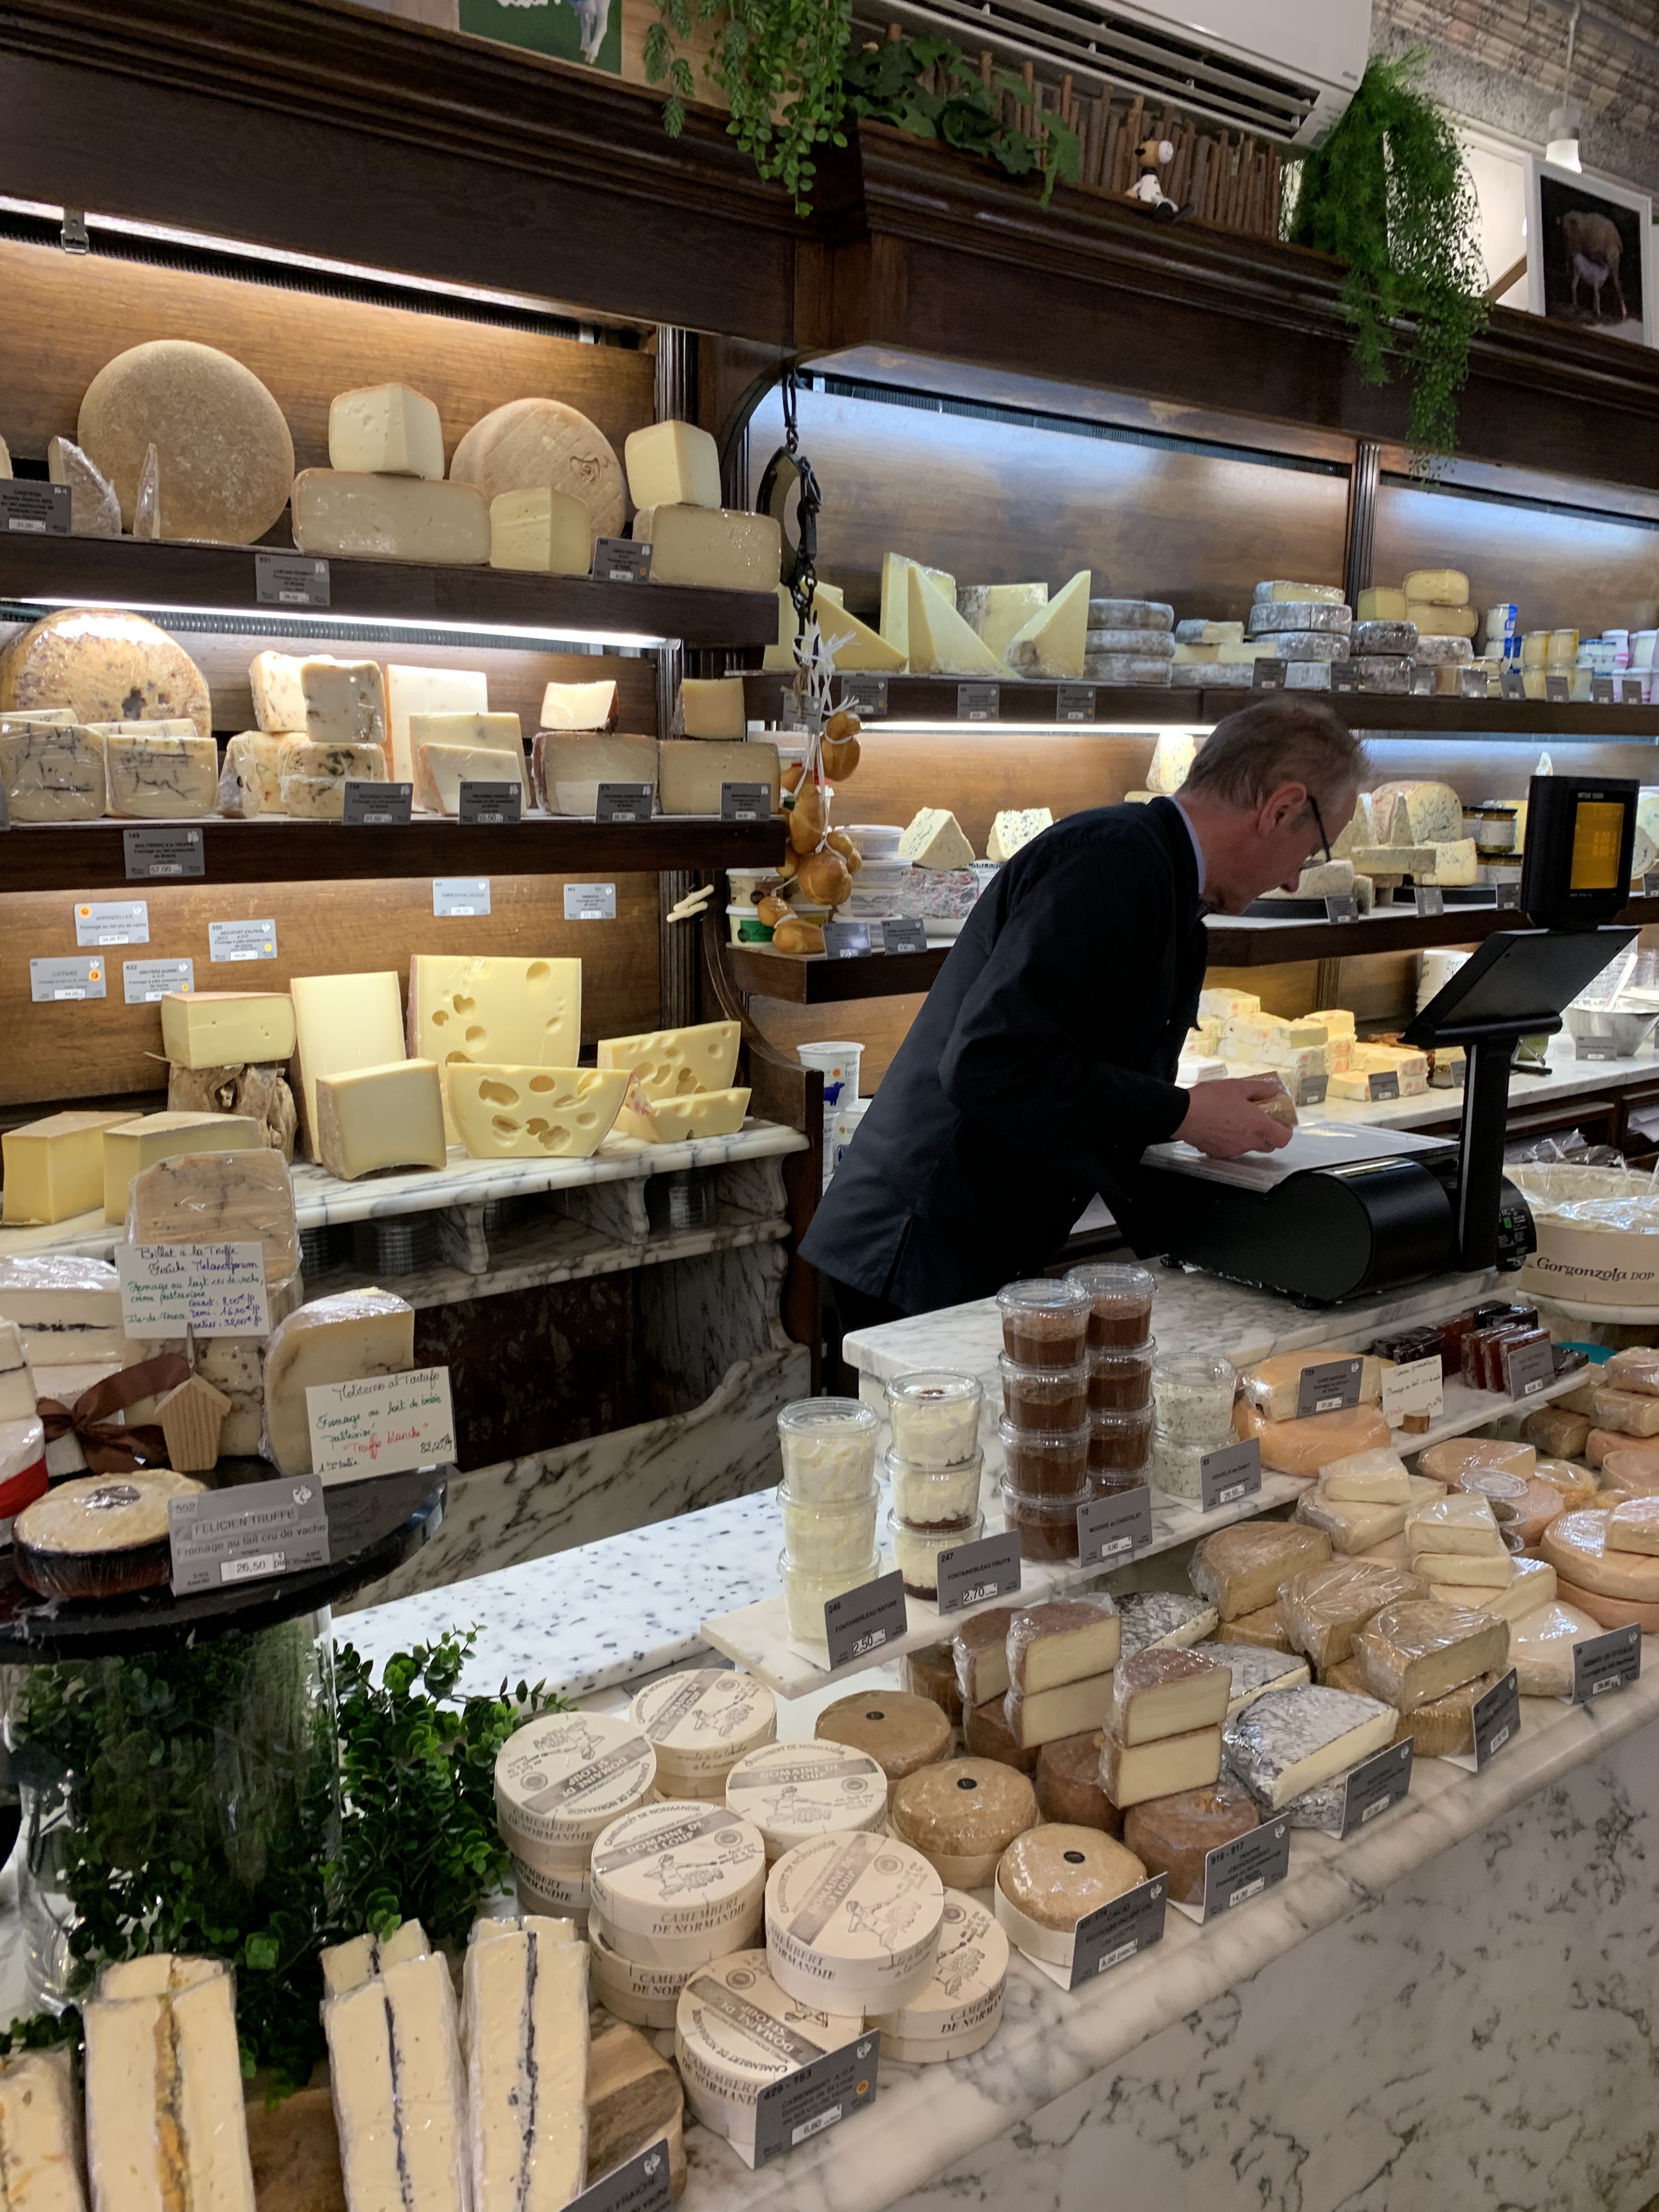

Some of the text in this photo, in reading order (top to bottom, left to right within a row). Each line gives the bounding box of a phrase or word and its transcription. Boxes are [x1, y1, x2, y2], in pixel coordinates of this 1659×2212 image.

[1537, 1257, 1655, 1282] Gorgonzola DOP
[195, 1509, 295, 1535] FELICIEN TRUFFE
[1081, 1508, 1089, 1516] 10
[177, 1523, 326, 1558] Fromage au lait cru de vache
[236, 1561, 266, 1573] 26,50
[941, 1552, 954, 1563] 247
[828, 1600, 842, 1615] 246
[626, 1827, 685, 1854] DOMAINE
[651, 1900, 747, 1935] DE NORMANDIE
[660, 1896, 738, 1923] CAMEMBERT
[695, 2070, 757, 2106] NORMAND
